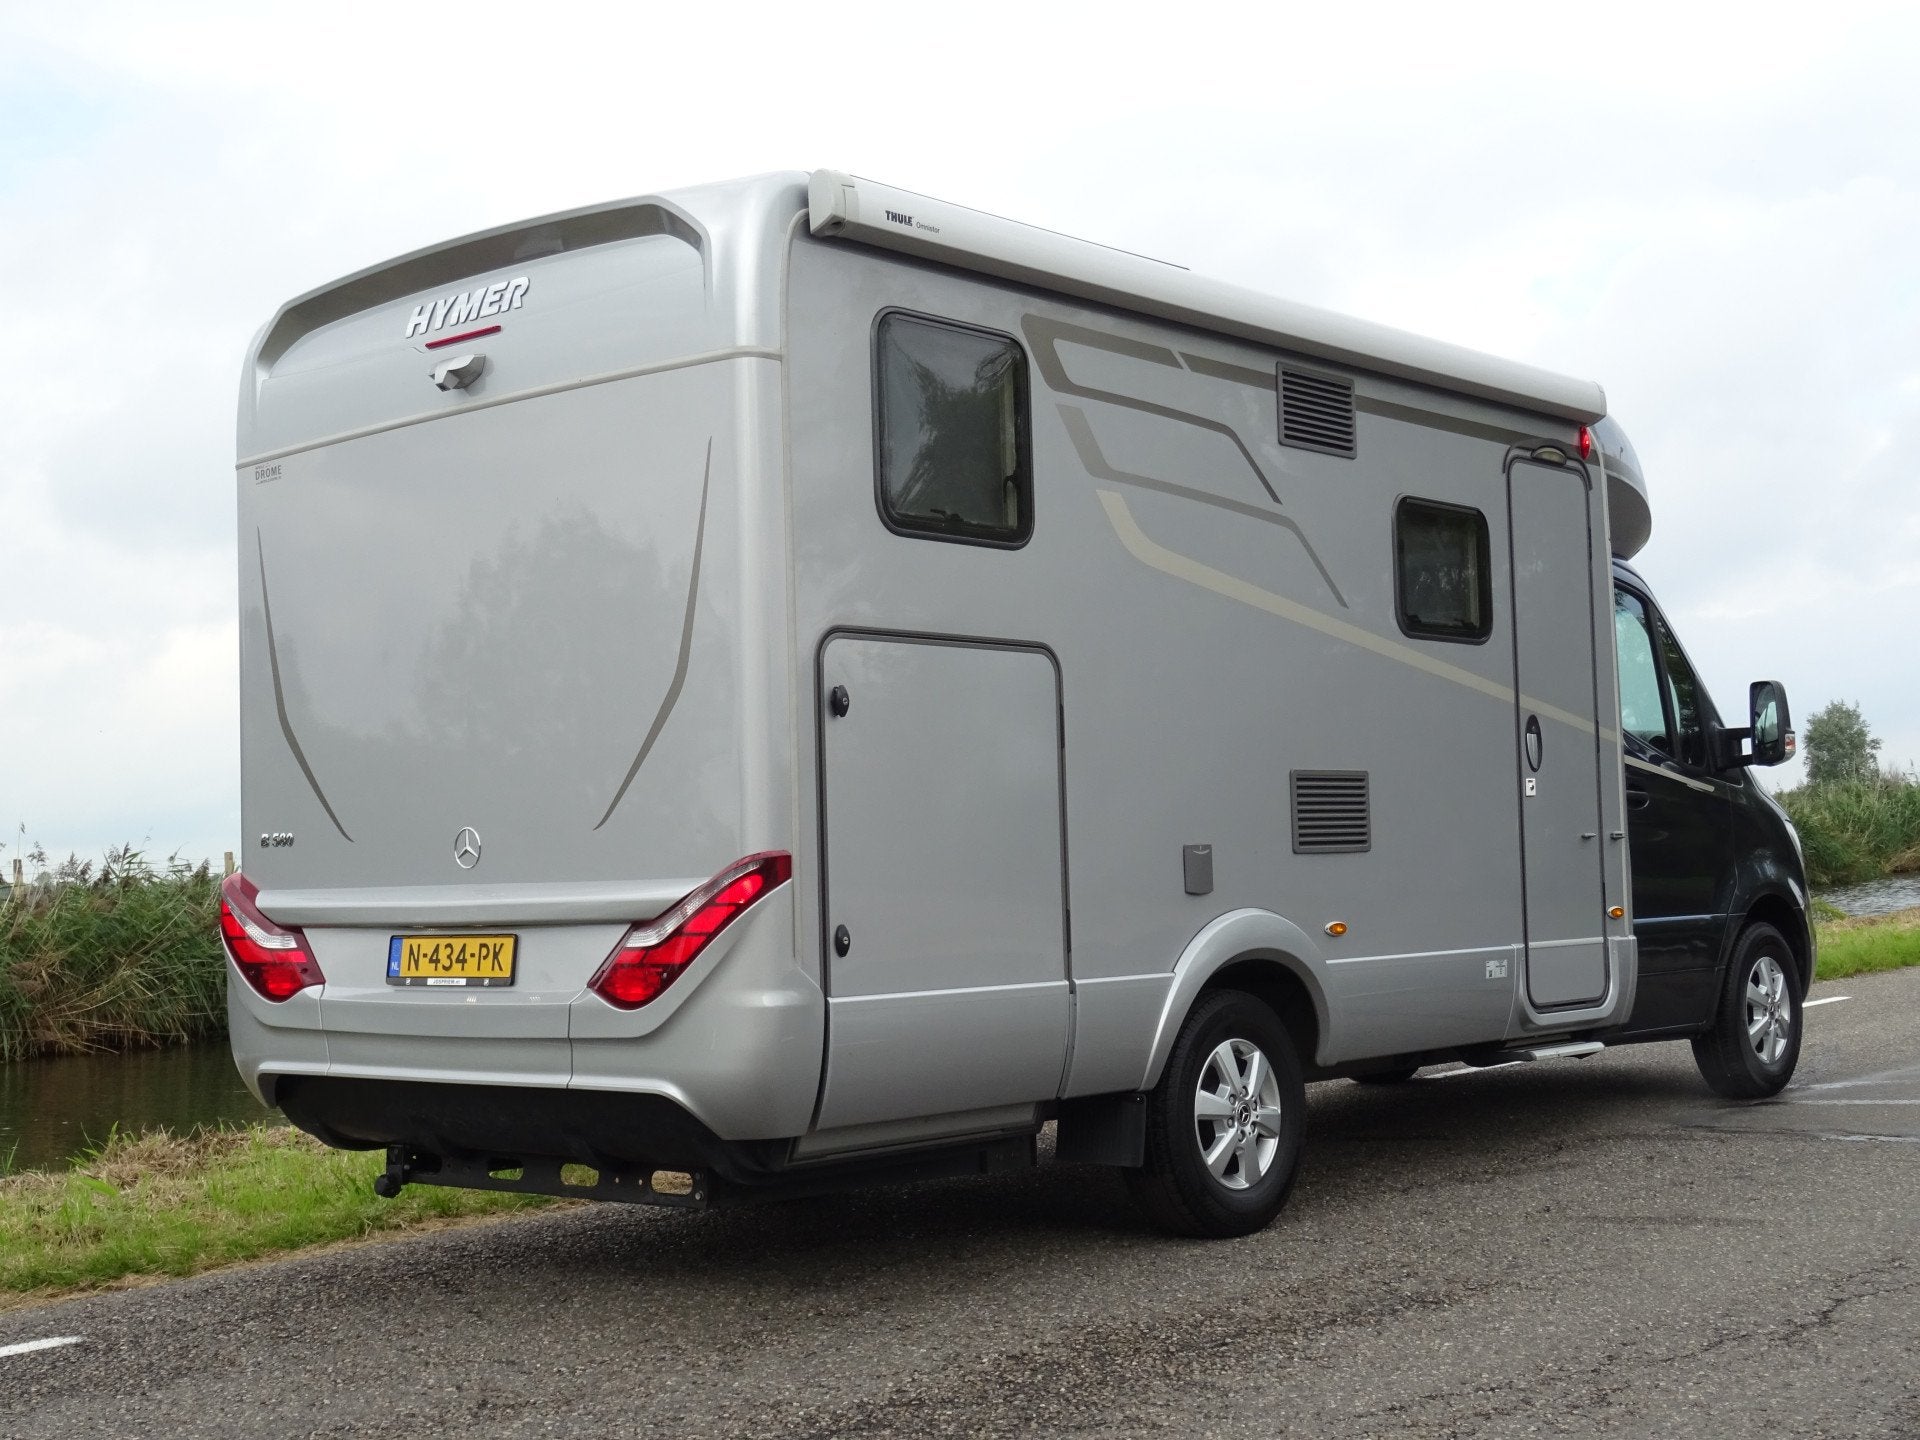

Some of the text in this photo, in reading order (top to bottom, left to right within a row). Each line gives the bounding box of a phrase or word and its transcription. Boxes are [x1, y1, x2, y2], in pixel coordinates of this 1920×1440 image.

[885, 210, 940, 234] THULE Omnistor
[405, 276, 530, 339] HYMER
[255, 464, 282, 481] DROME
[391, 943, 505, 972] NL N-434-PK
